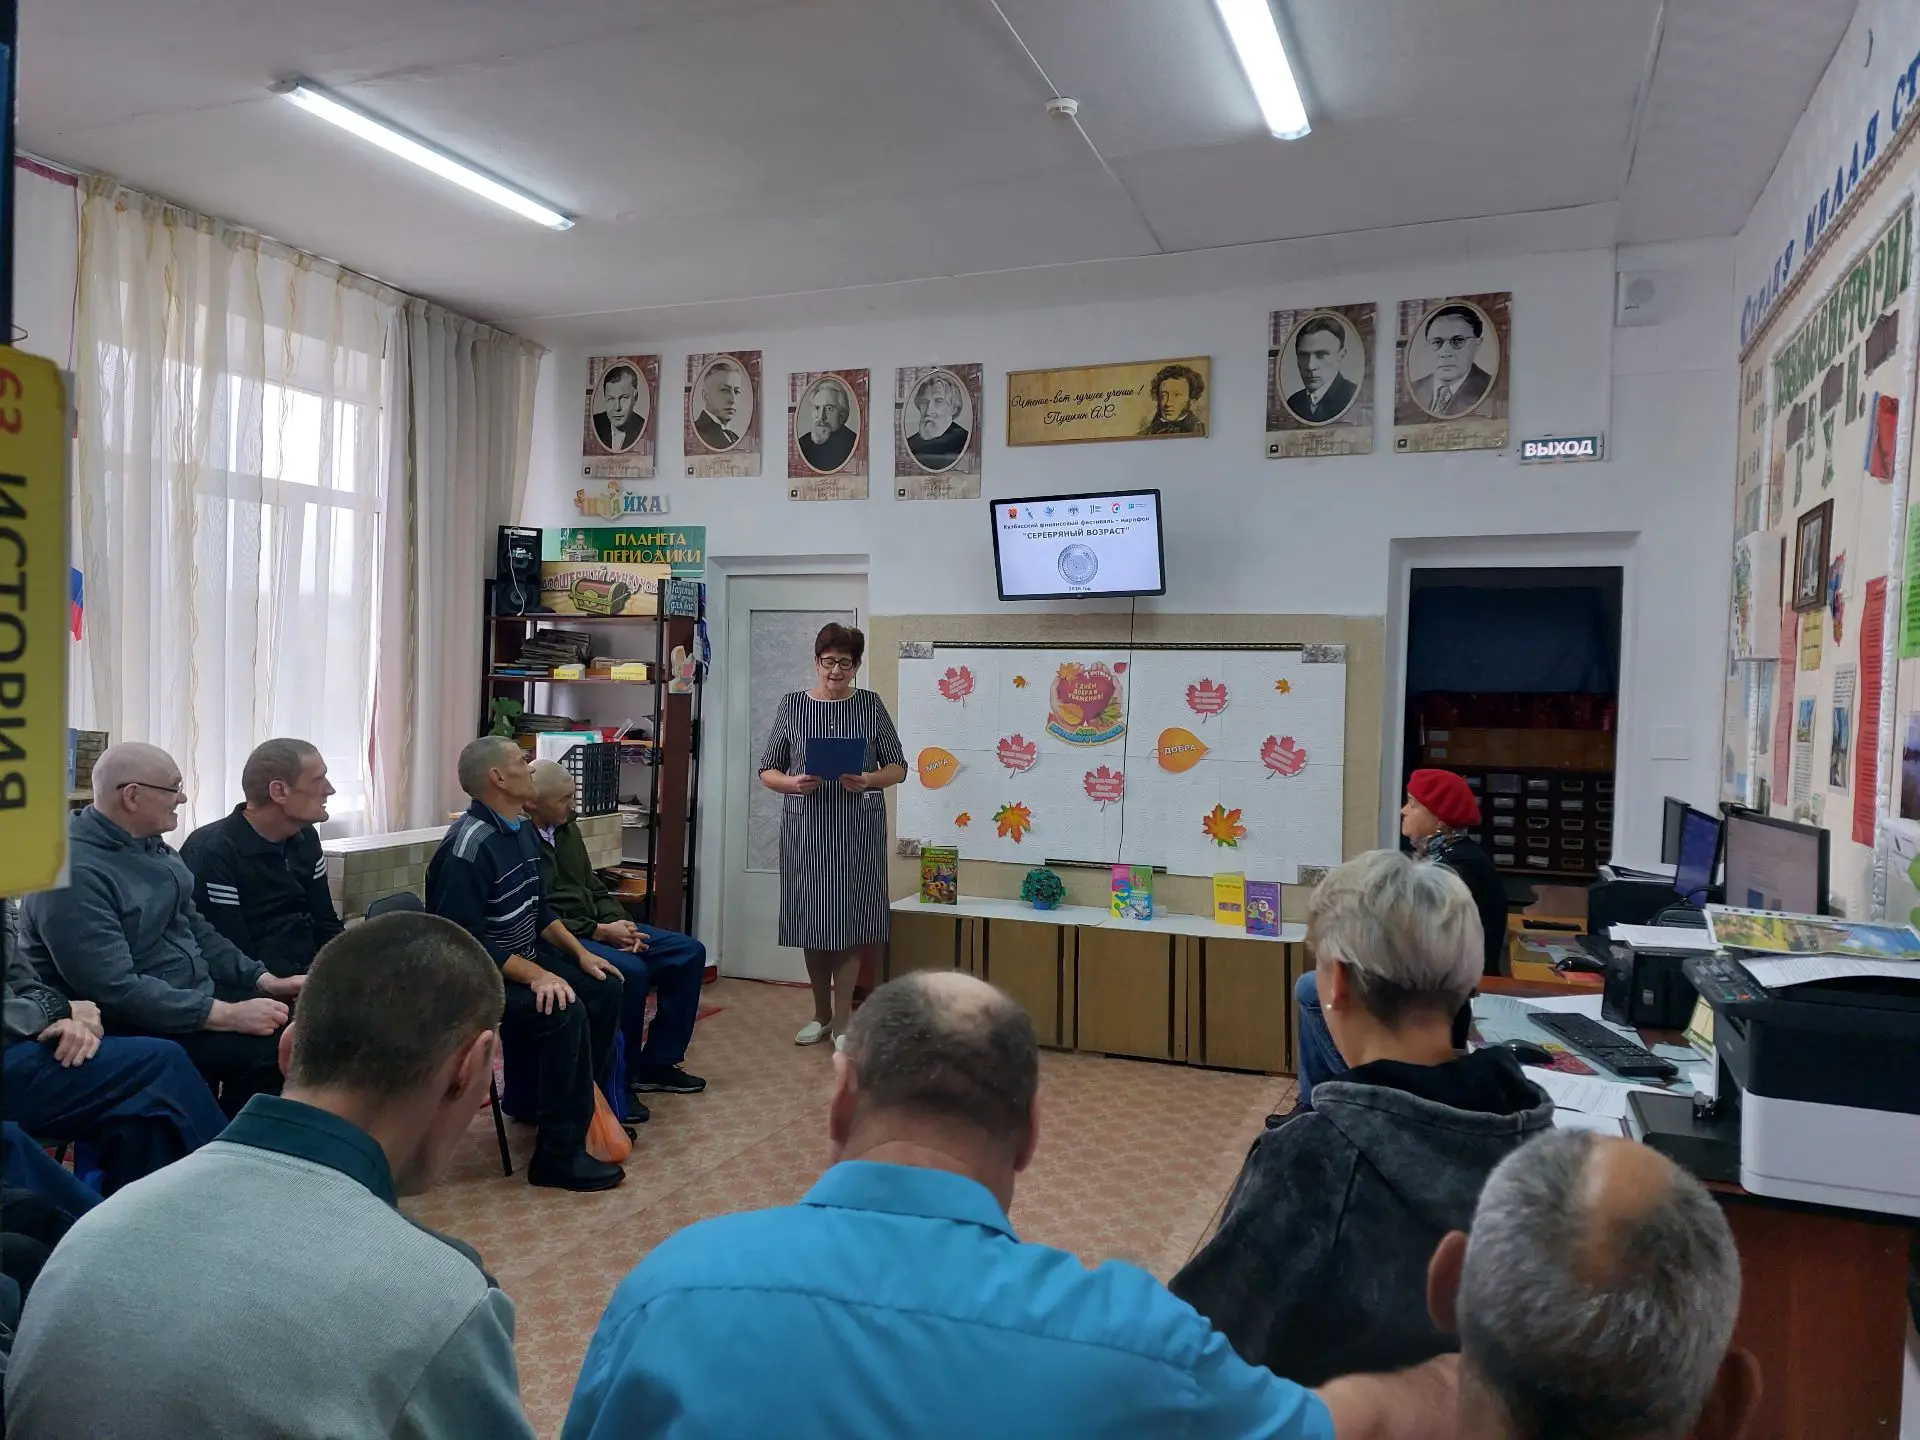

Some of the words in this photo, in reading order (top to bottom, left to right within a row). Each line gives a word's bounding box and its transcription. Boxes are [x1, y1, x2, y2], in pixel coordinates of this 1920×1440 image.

[1043, 411, 1088, 426] Пушкин
[1524, 440, 1594, 457] ВЫХОД
[1003, 522, 1038, 530] Кузбасский
[1081, 518, 1114, 527] фестиваль
[1121, 516, 1150, 524] марафон
[615, 532, 687, 546] ПЛАНЕТА
[1023, 528, 1084, 540] "СЕРЕБРЯНЫЙ
[1087, 526, 1130, 536] ВОЗРАСТ"
[603, 549, 701, 563] ПЕРИОДИКИ
[1164, 744, 1197, 756] ДОБРА
[926, 759, 949, 773] МИРА
